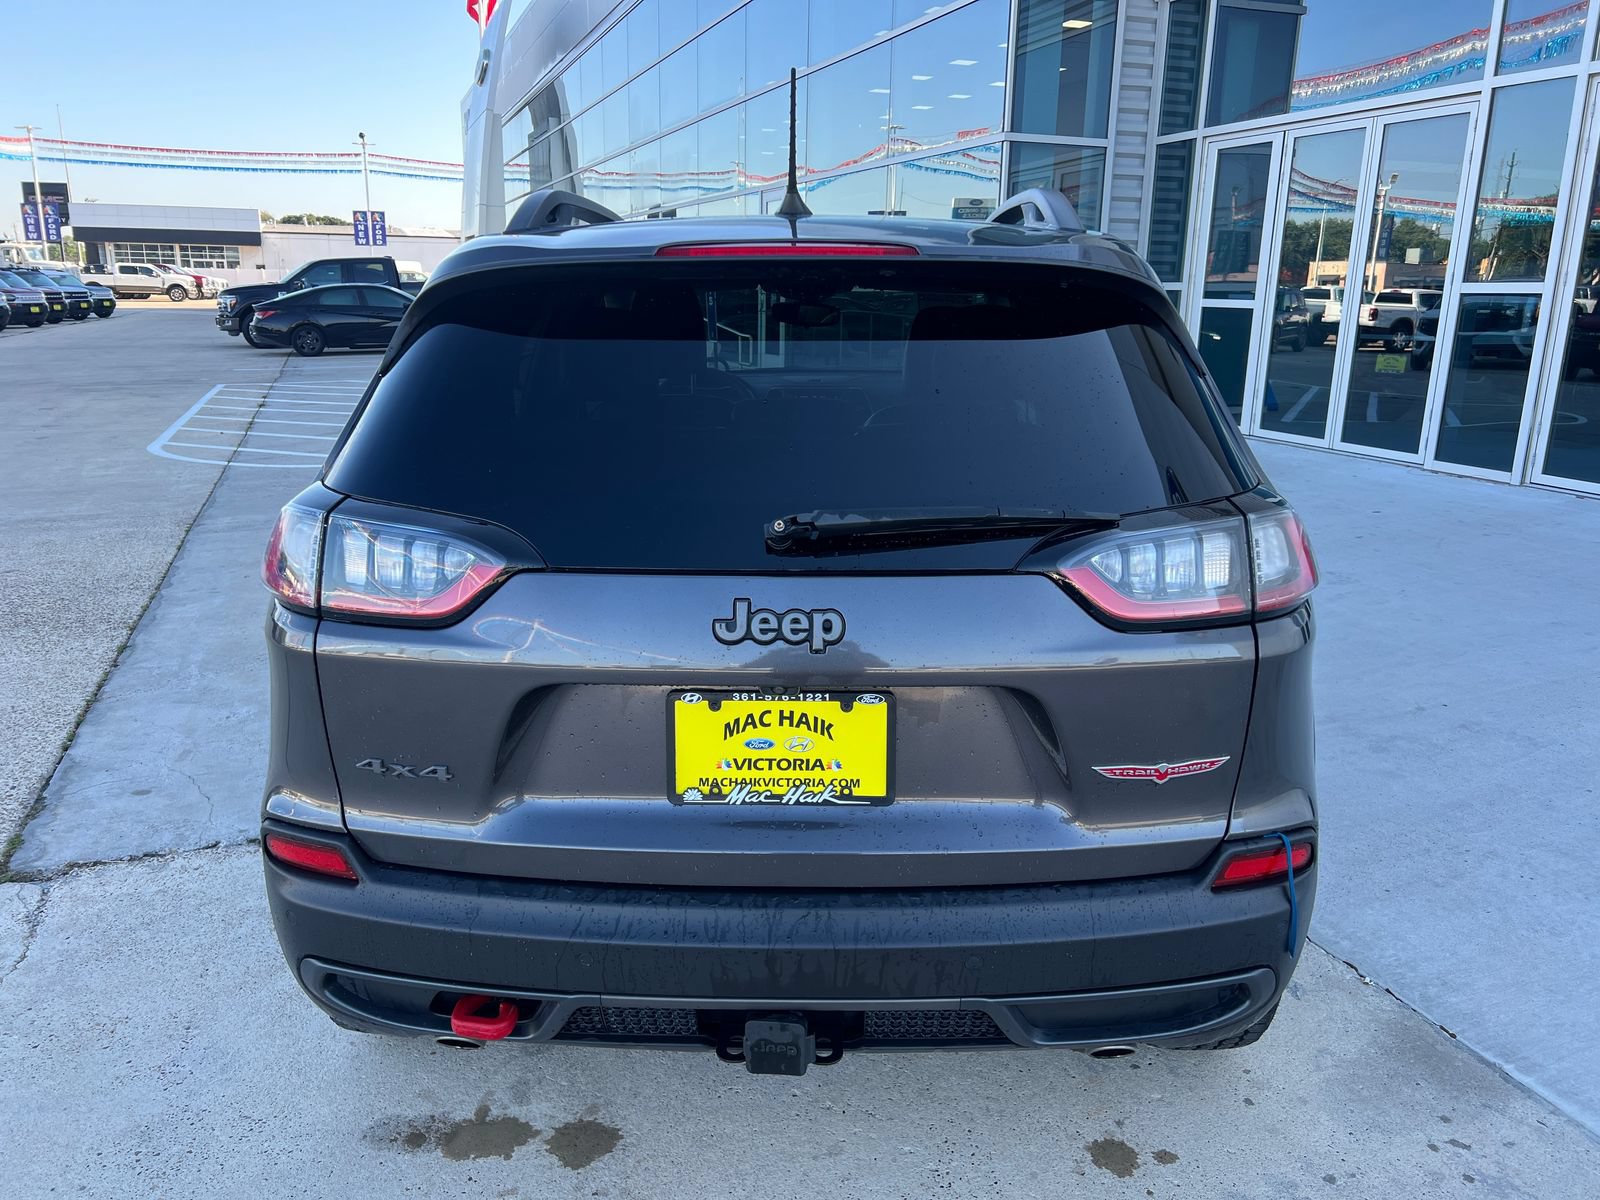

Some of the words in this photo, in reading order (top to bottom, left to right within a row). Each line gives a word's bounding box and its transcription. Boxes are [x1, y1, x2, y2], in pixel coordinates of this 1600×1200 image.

[26, 218, 38, 240] NEW
[47, 218, 58, 240] FORD
[357, 224, 367, 245] NEW
[375, 224, 383, 245] FORD
[712, 597, 846, 654] Jeep
[859, 694, 882, 704] Ford
[723, 709, 772, 741] MAC
[778, 709, 835, 741] HAIK
[748, 739, 770, 749] Ford
[355, 758, 454, 780] 4x4
[732, 758, 825, 771] VICTORIA
[1111, 768, 1160, 776] TRAIL
[1167, 762, 1211, 775] HAWK
[698, 777, 861, 789] MACHAIKVICTORIACOM
[726, 783, 773, 805] Mac
[781, 784, 838, 805] Haik
[752, 1040, 798, 1057] Jeep
